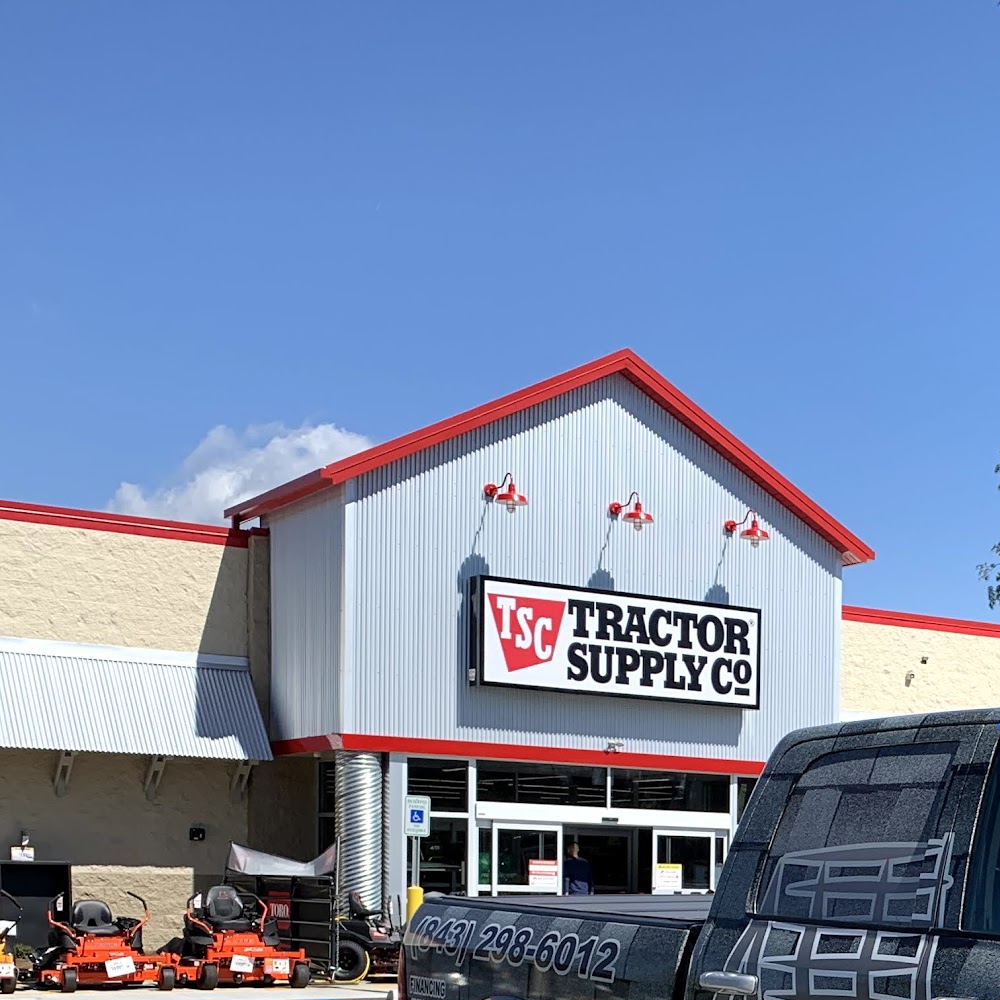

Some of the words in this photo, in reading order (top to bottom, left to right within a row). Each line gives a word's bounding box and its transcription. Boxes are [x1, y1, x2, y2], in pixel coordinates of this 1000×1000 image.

[496, 596, 553, 660] TSC
[568, 599, 751, 655] TRACTOR
[567, 642, 708, 692] SUPPLY
[270, 903, 289, 918] TORO
[410, 916, 477, 967] (843)
[472, 923, 620, 984] 298-6012
[410, 975, 446, 999] FINANCING
